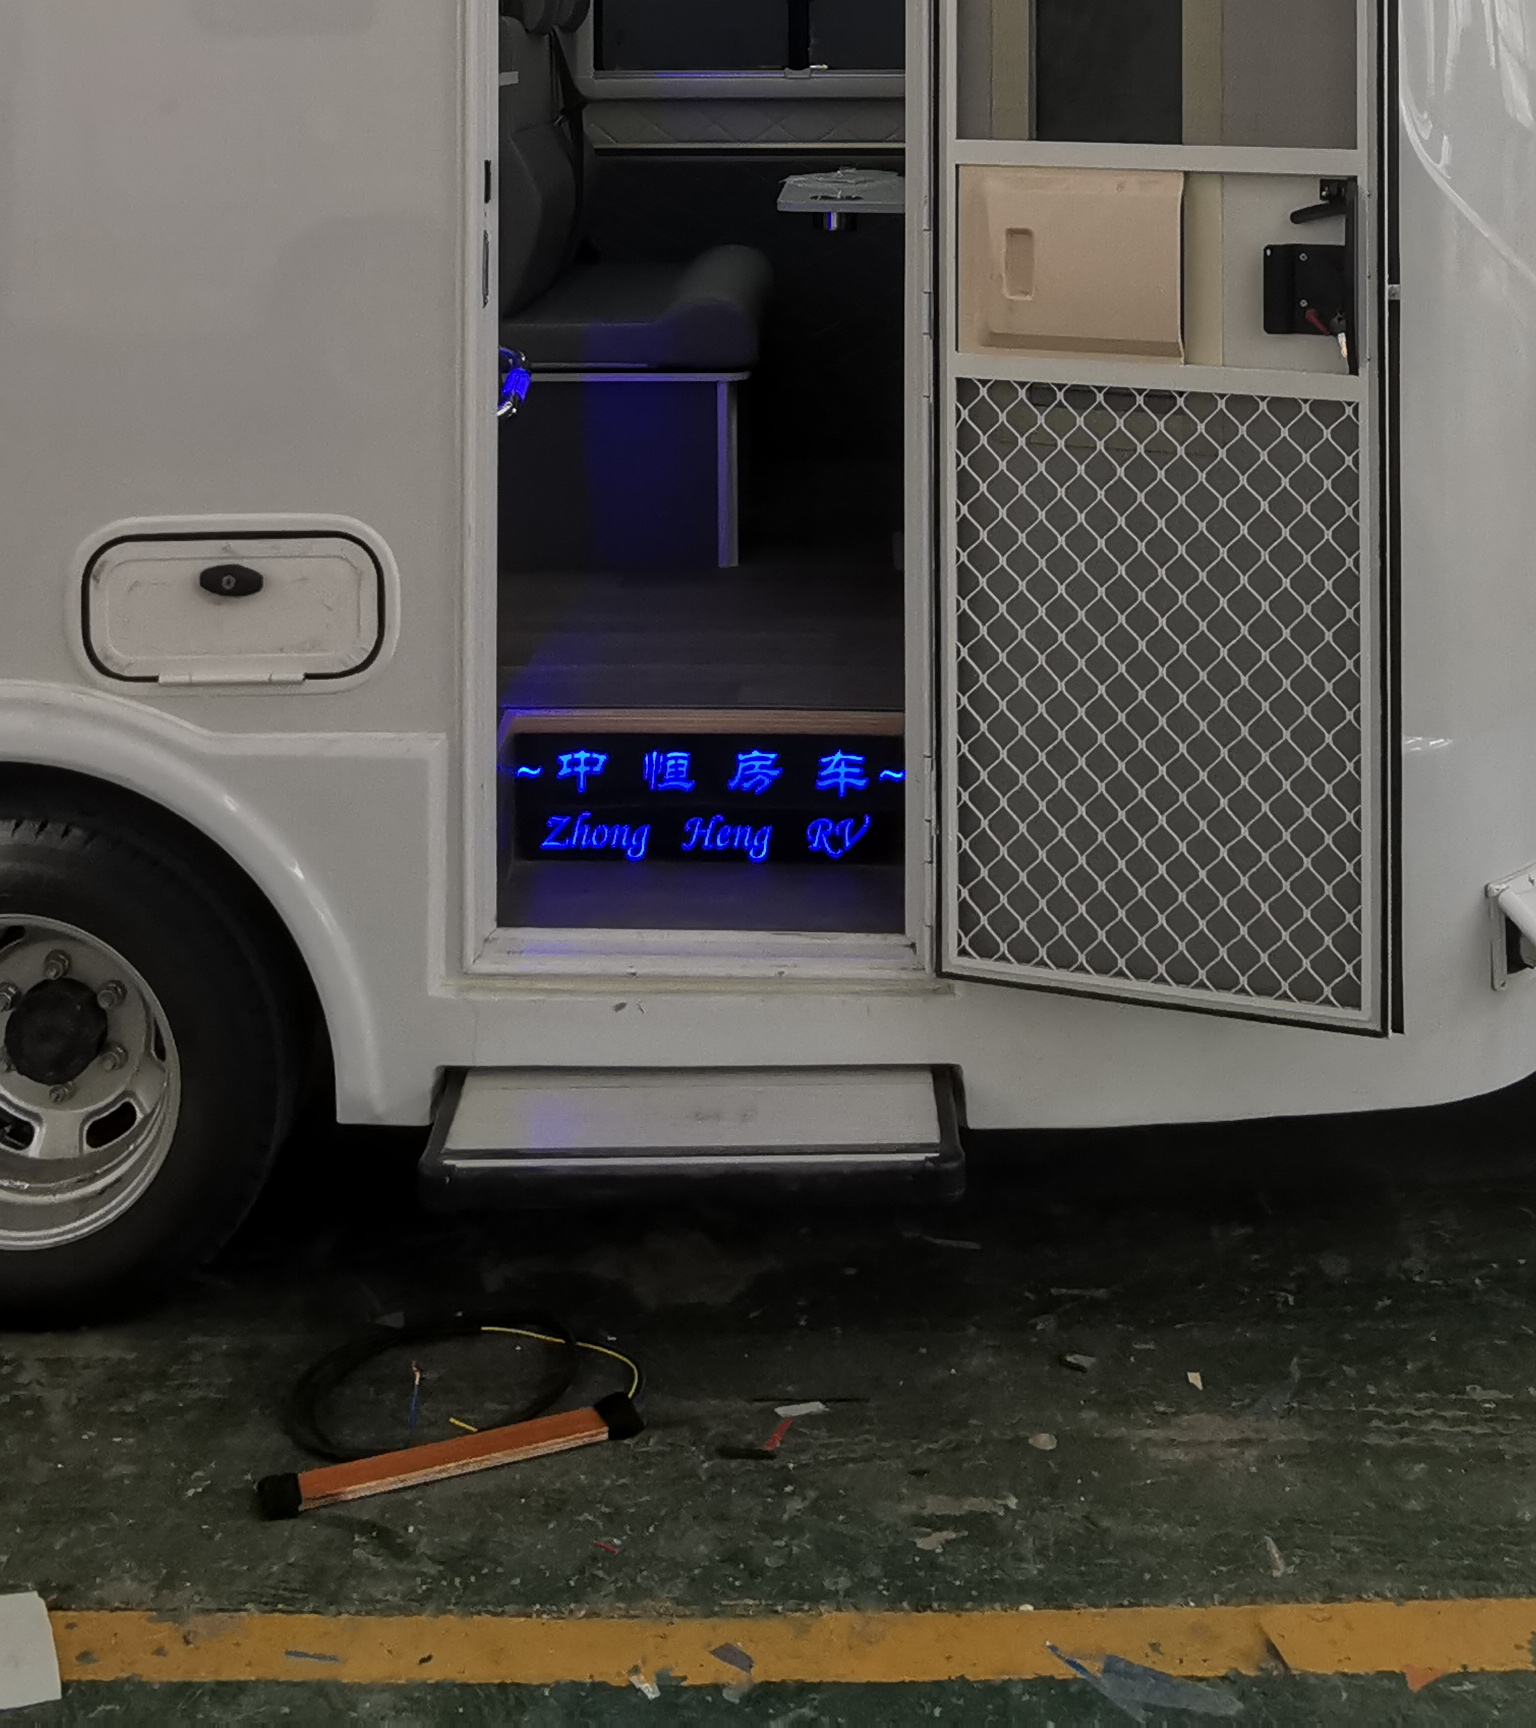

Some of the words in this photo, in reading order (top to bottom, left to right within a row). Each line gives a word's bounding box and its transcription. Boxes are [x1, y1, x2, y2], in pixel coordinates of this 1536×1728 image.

[540, 811, 651, 862] Zhong
[681, 814, 773, 863] Heng
[806, 814, 871, 862] RV
